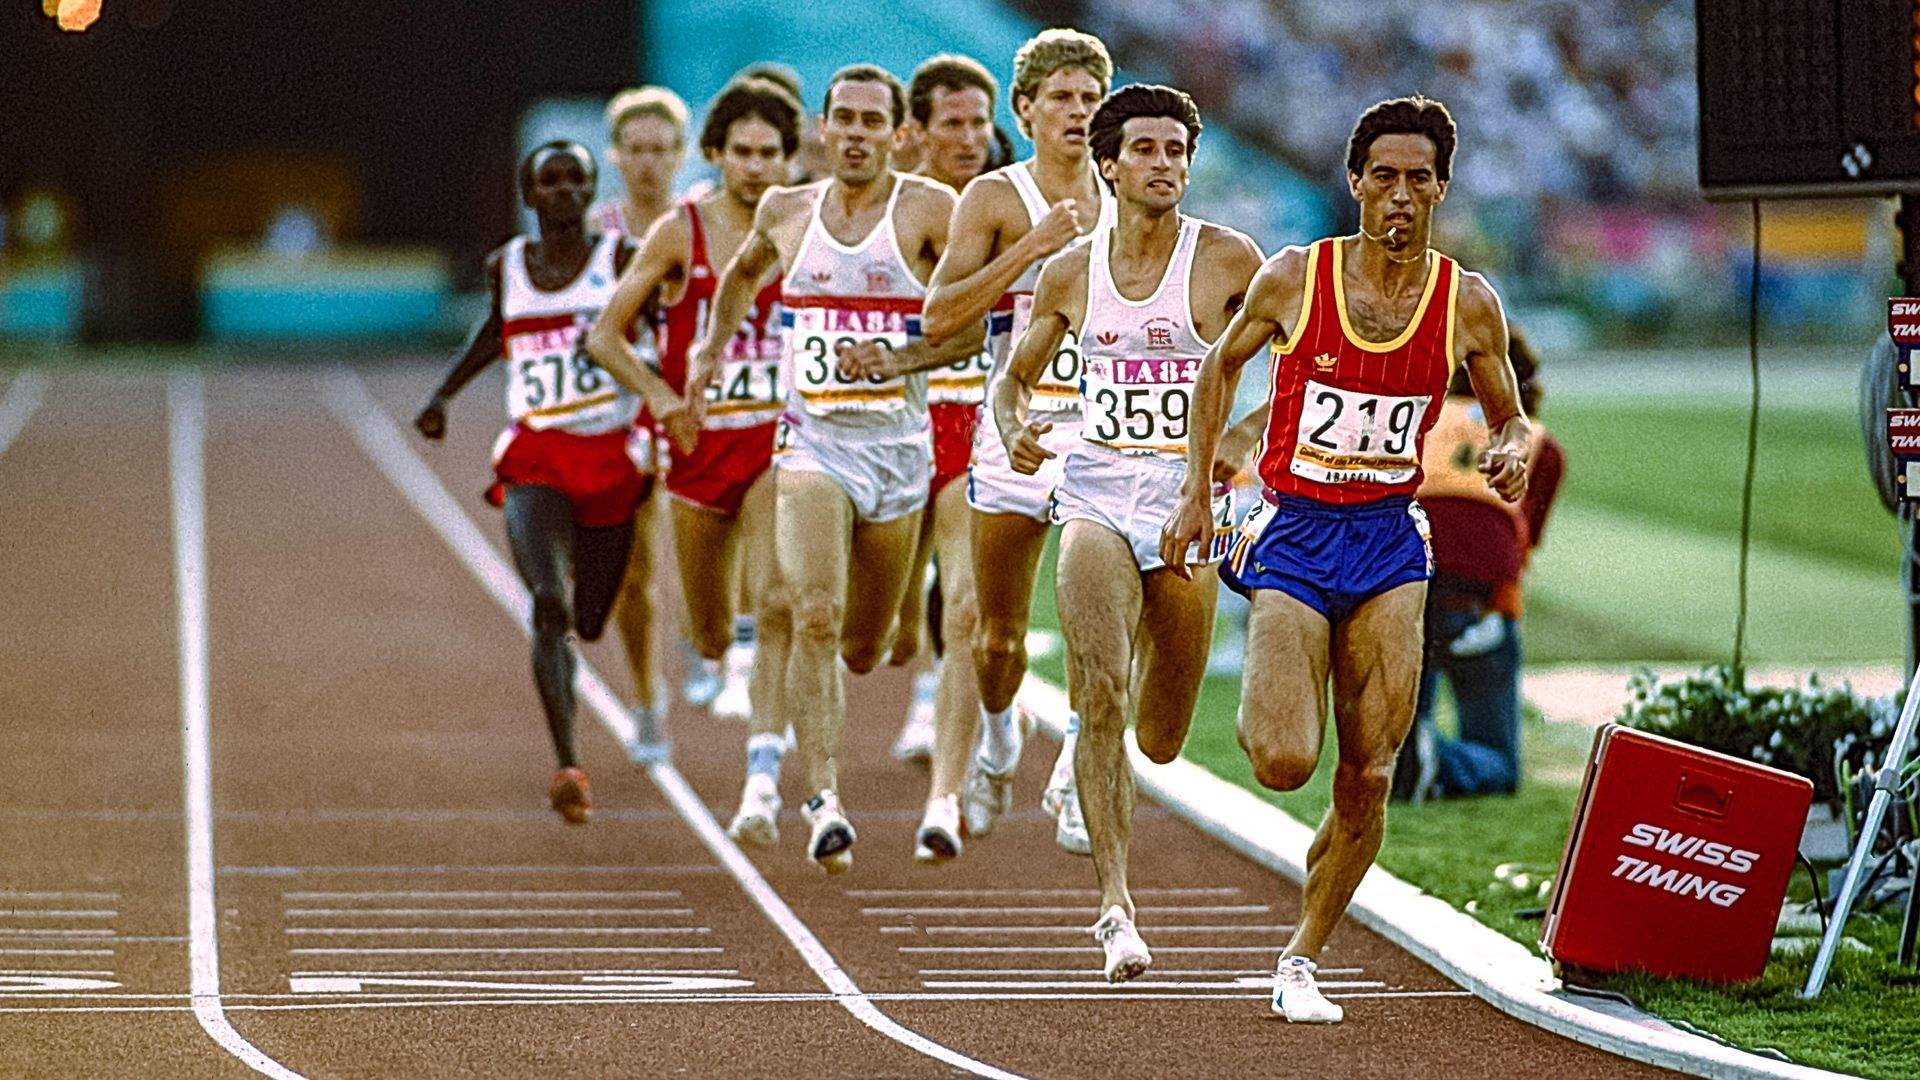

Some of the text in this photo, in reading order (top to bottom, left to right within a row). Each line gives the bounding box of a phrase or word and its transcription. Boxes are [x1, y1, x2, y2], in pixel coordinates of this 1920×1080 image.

[1891, 303, 1920, 316] SW
[521, 355, 600, 406] 578
[1095, 389, 1187, 441] 359
[1309, 391, 1415, 455] 219
[1889, 415, 1920, 428] SW
[1622, 823, 1760, 874] SWISS
[1611, 855, 1746, 907] TIMING
